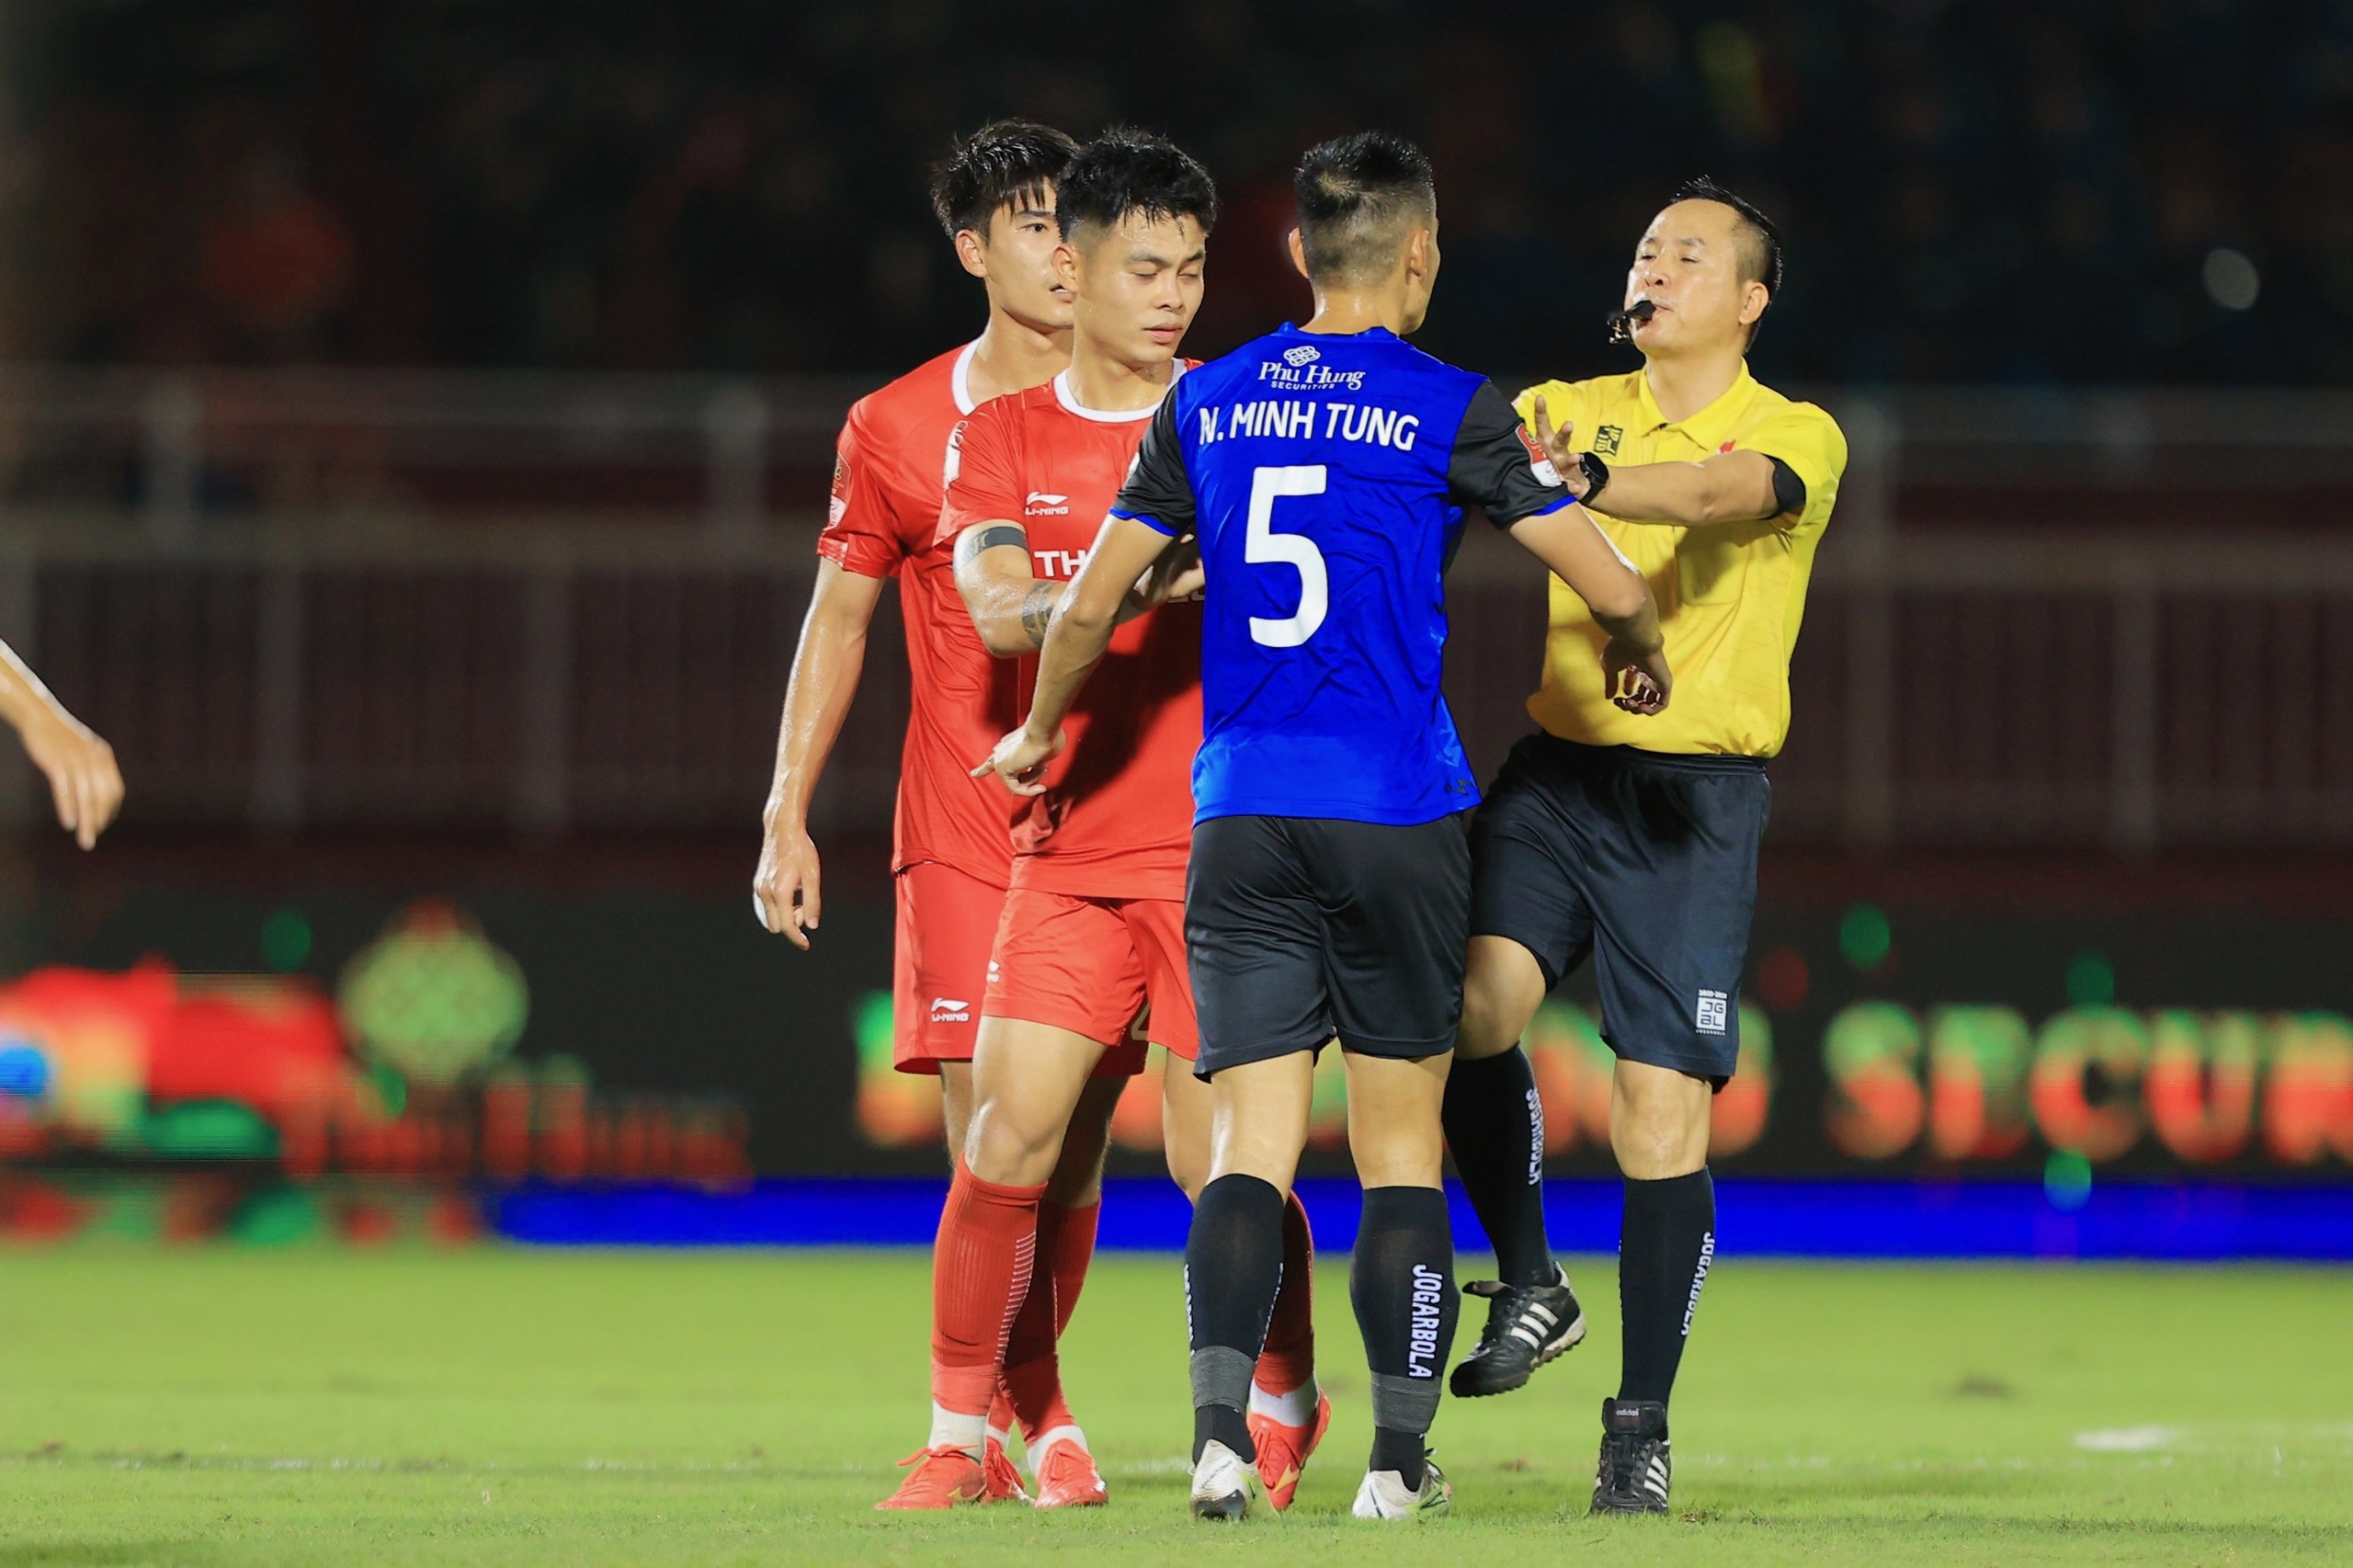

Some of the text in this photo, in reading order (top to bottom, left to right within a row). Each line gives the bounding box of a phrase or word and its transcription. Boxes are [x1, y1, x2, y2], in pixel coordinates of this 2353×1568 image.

[1257, 361, 1366, 391] Phu Hung
[1270, 381, 1336, 391] SECURITIES
[1199, 400, 1420, 451] N. MINH TUNG
[1025, 506, 1069, 516] LI-NING
[1245, 464, 1329, 648] 5
[931, 1013, 970, 1022] LI-NING
[1680, 1232, 1715, 1335] JOGARBOLA
[1408, 1264, 1443, 1377] JOGARBOLA
[1616, 1408, 1640, 1416] adidas
